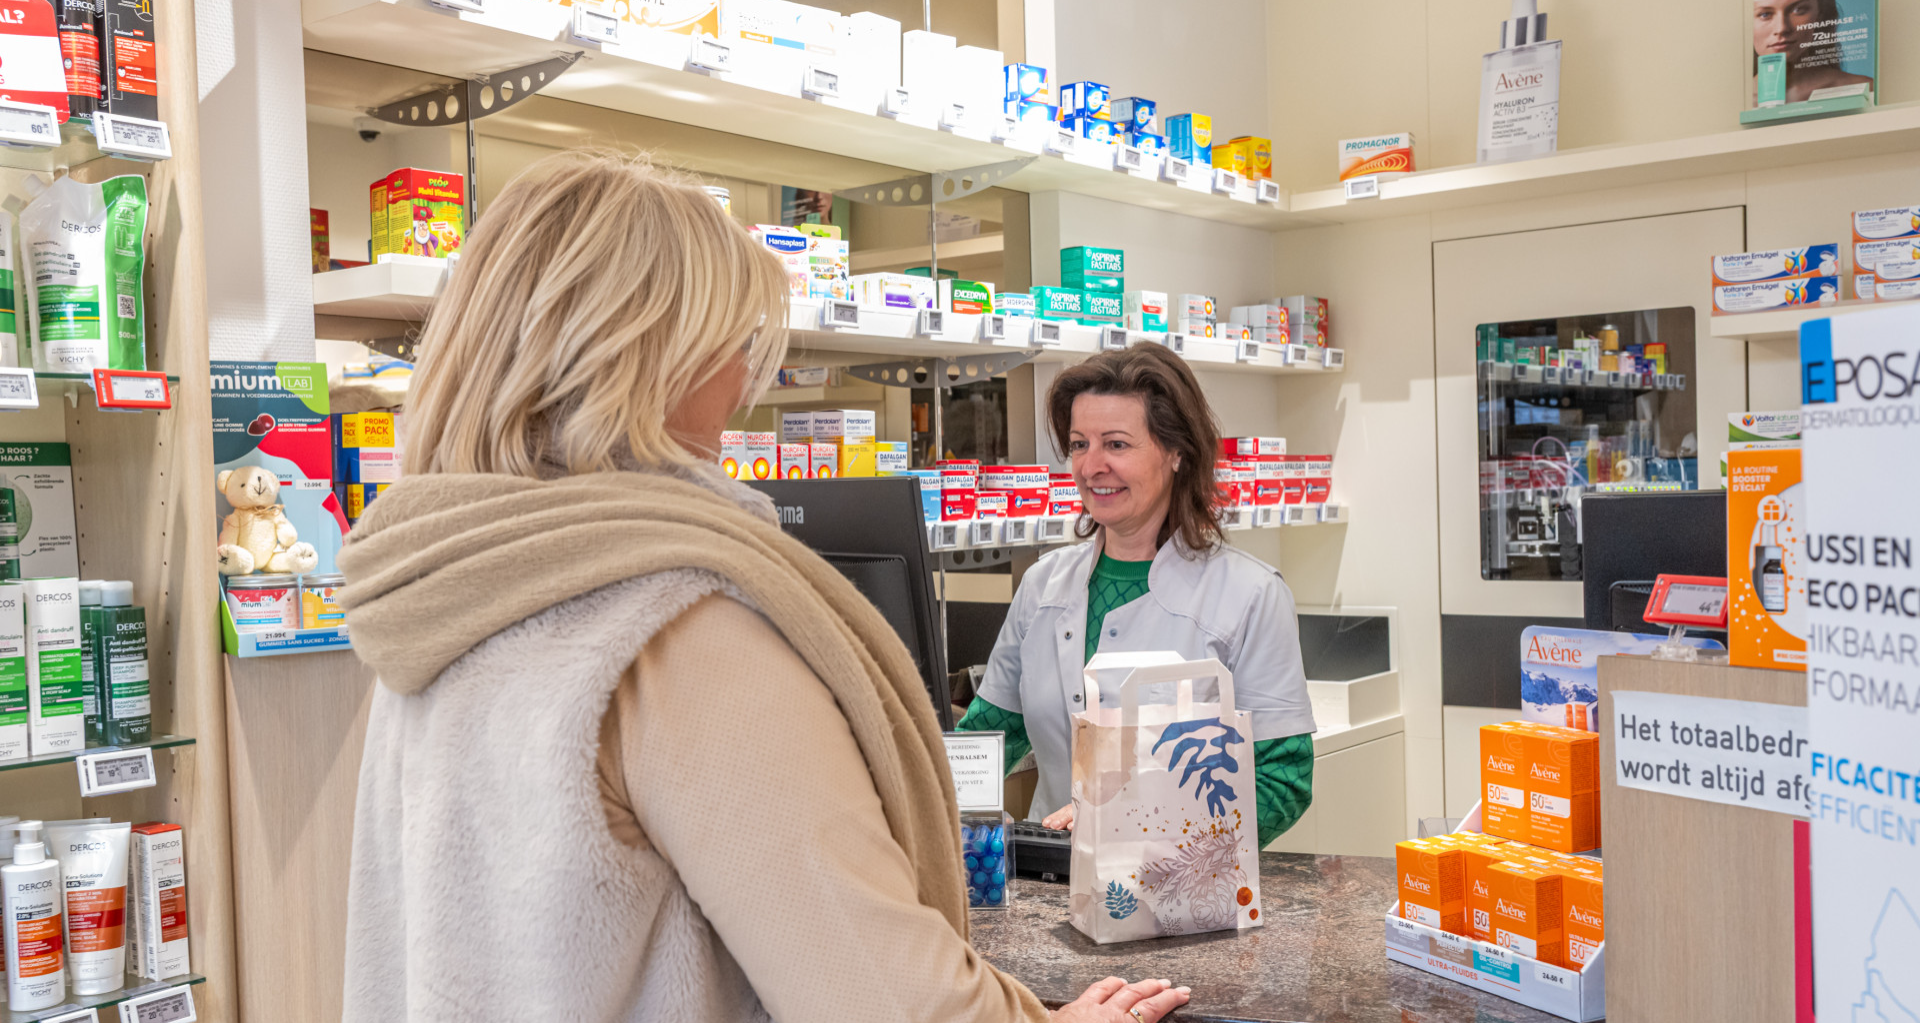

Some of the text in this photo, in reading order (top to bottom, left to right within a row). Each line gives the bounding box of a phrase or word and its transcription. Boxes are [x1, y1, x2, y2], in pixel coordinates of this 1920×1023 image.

[1796, 16, 1854, 31] HYDRAPHASE
[1812, 32, 1830, 40] 72u
[1496, 73, 1543, 91] Avène
[1494, 96, 1535, 109] HYALURON
[1493, 108, 1515, 116] ACTIV
[1345, 137, 1400, 150] PROMAGNOR
[62, 220, 101, 233] DERCOS
[768, 238, 804, 247] Hansaplast
[1091, 253, 1122, 263] ASPIRINE
[1752, 251, 1778, 260] Emulgel
[1091, 261, 1122, 271] FASTTABS
[954, 289, 987, 300] EXCEDRYN
[1050, 292, 1081, 302] ASPIRINE
[1050, 301, 1080, 312] FASTTABS
[1091, 297, 1121, 307] ASPIRINE
[1091, 305, 1120, 316] FASTTABS
[210, 370, 281, 390] mium
[288, 378, 308, 388] LAB
[364, 426, 389, 434] PACK
[365, 436, 390, 444] 45+15
[1744, 466, 1778, 474] ROUTINE
[1874, 537, 1910, 568] EN
[36, 593, 72, 602] DERCOS
[1808, 579, 1858, 610] ECO
[1699, 602, 1711, 612] 44
[1527, 635, 1582, 663] Avène
[1620, 714, 1661, 742] Het
[1487, 755, 1515, 772] Avène
[1530, 762, 1560, 781] Avène
[1620, 760, 1691, 786] wordt
[1701, 764, 1764, 800] altijd
[1489, 785, 1500, 800] 50
[70, 842, 106, 852] DERCOS
[152, 840, 180, 850] DERCOS
[18, 880, 53, 892] DERCOS
[1404, 873, 1430, 892] Avène
[1406, 906, 1418, 919] 50
[1496, 898, 1526, 920] Avène
[1568, 905, 1602, 927] Avène
[1497, 932, 1511, 948] 50
[1585, 938, 1599, 946] FLUID
[1572, 942, 1584, 959] 50
[1479, 954, 1512, 970] OIL-CONTROL
[1428, 958, 1478, 981] ULTRA-FLUIDES
[30, 988, 51, 996] VICHY
